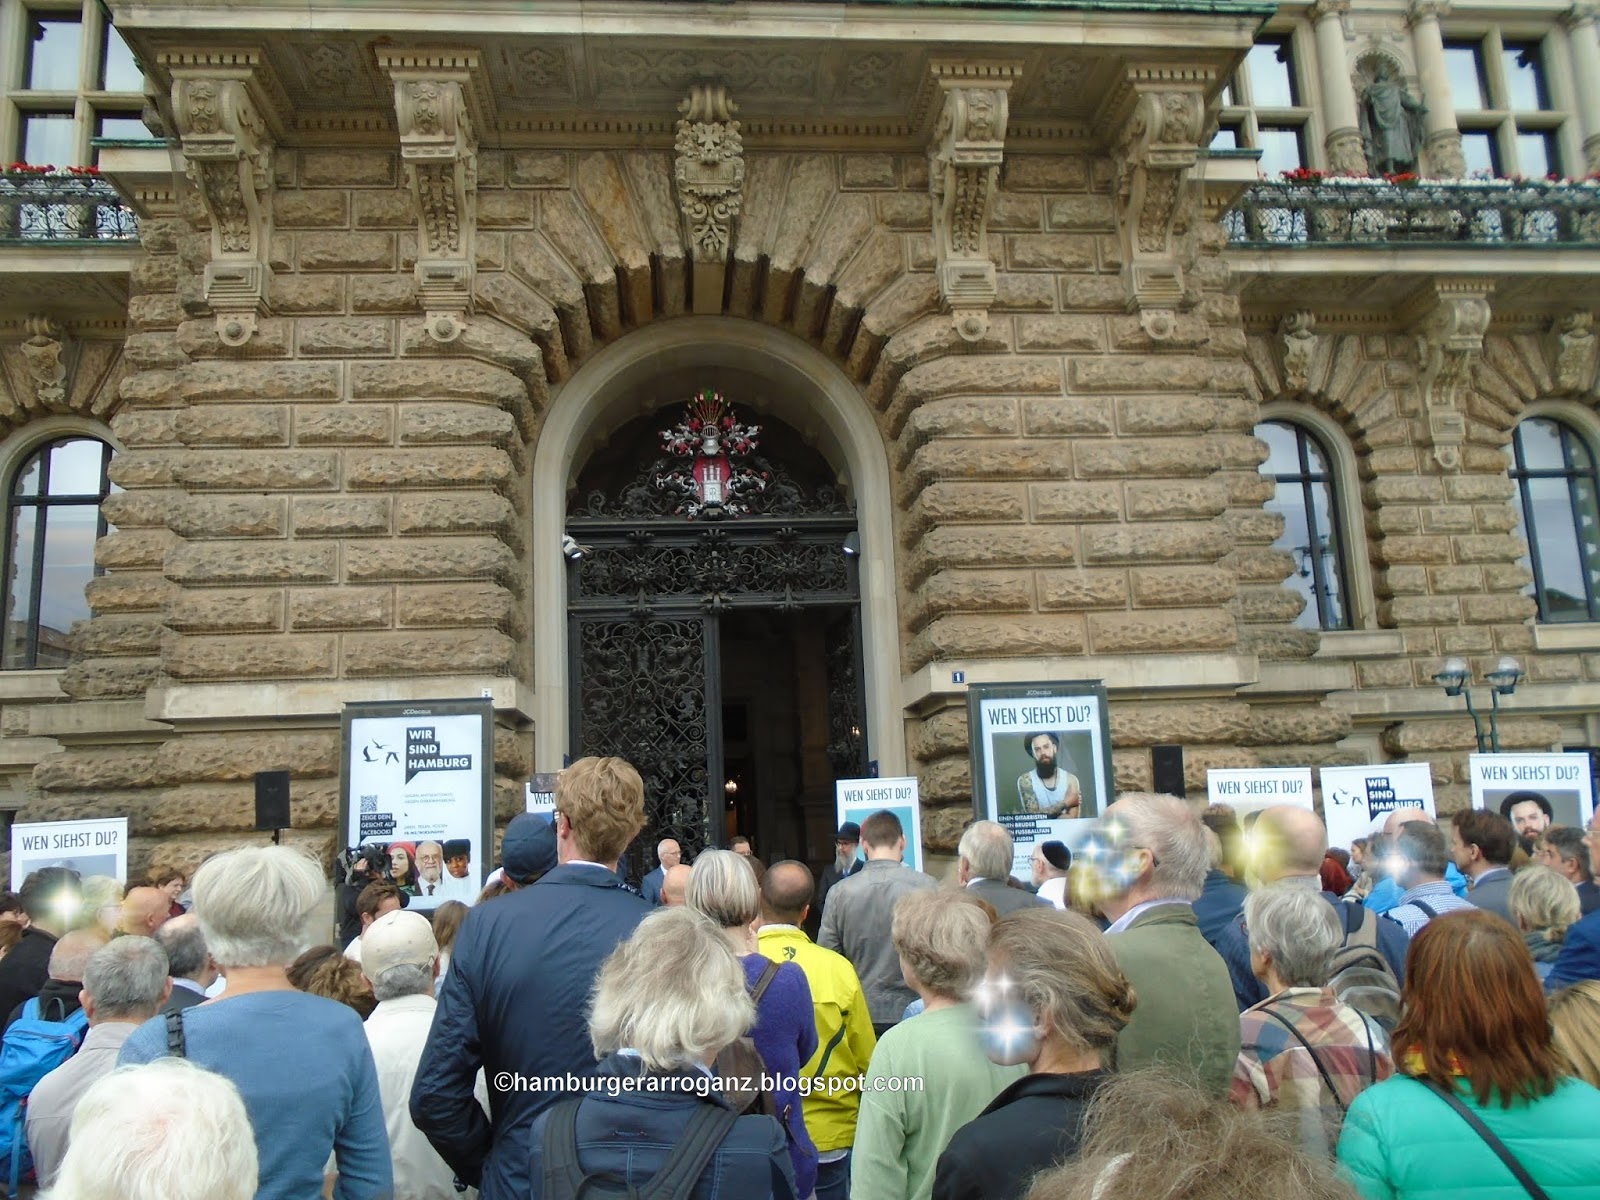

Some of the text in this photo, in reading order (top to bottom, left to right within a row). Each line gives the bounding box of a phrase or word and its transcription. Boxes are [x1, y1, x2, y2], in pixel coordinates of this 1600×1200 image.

[955, 672, 960, 682] 1
[988, 705, 1091, 726] WEN SIEHST DU?
[408, 729, 433, 740] WIR
[408, 744, 438, 755] SIND
[408, 757, 469, 769] HAMBURG
[1481, 765, 1580, 780] WEN SIEHST DU?
[1217, 780, 1303, 794] WEN SIEHST DU?
[1367, 778, 1388, 788] WIR
[533, 792, 554, 805] WEN
[844, 787, 912, 802] WEN SIEHST DU?
[1368, 790, 1394, 799] SIND
[1370, 800, 1422, 811] HAMBURG
[22, 830, 118, 851] WEN SIEHST DU?
